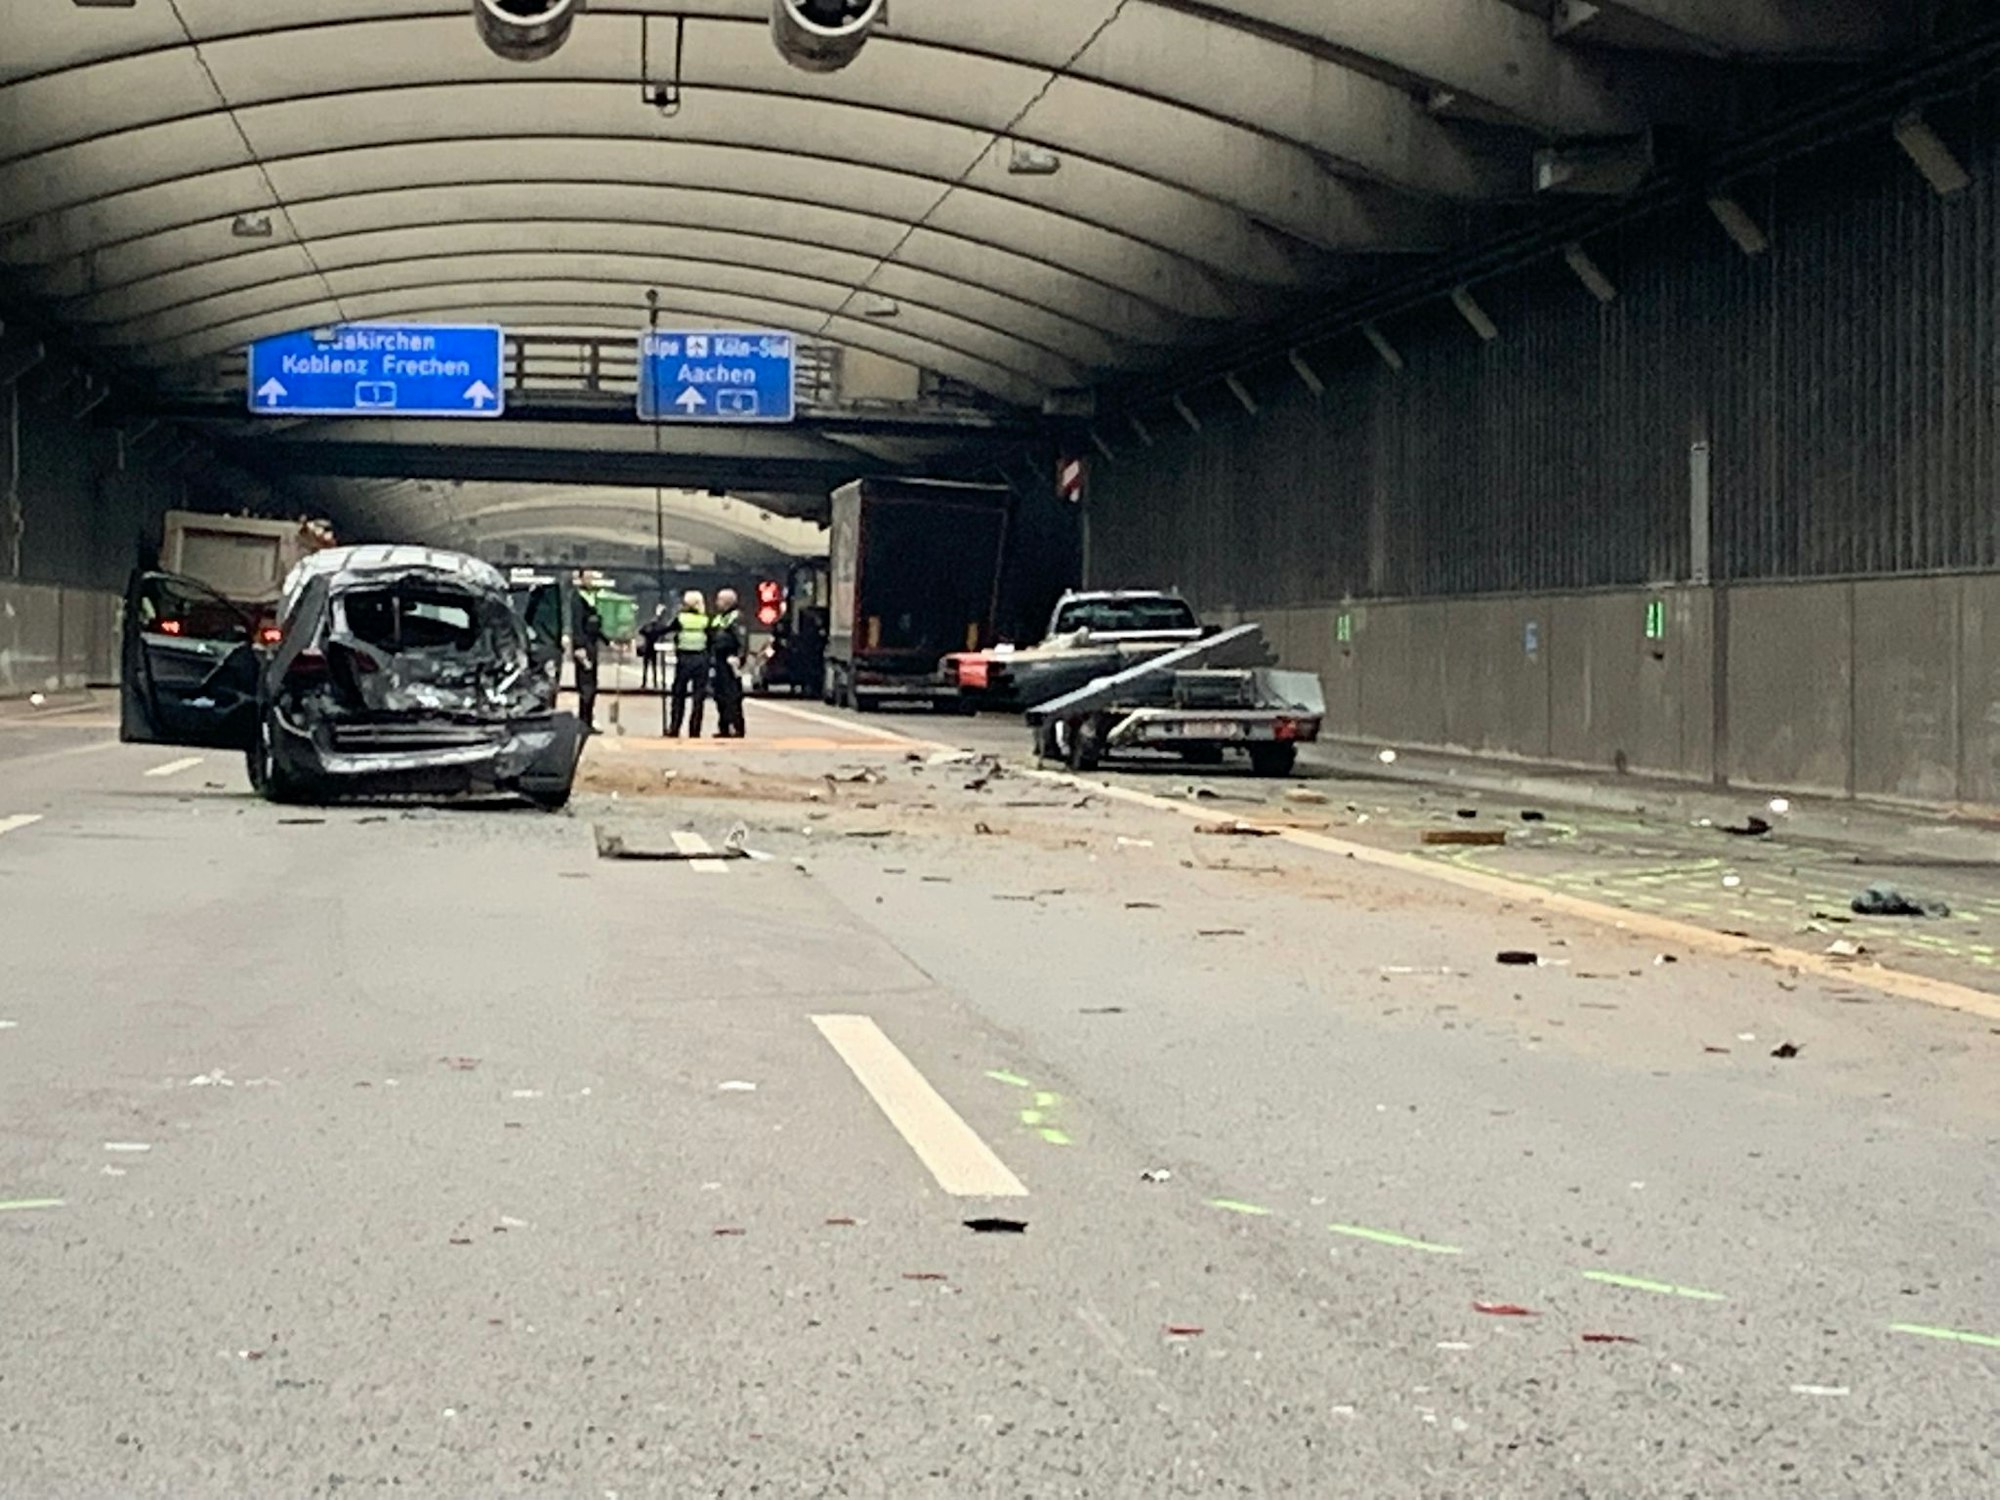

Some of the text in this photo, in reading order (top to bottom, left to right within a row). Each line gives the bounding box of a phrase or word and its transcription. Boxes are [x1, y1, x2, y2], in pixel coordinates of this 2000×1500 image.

[317, 331, 435, 351] uskirchen
[282, 354, 470, 376] Koblenz Frechen
[677, 363, 757, 384] Aachen
